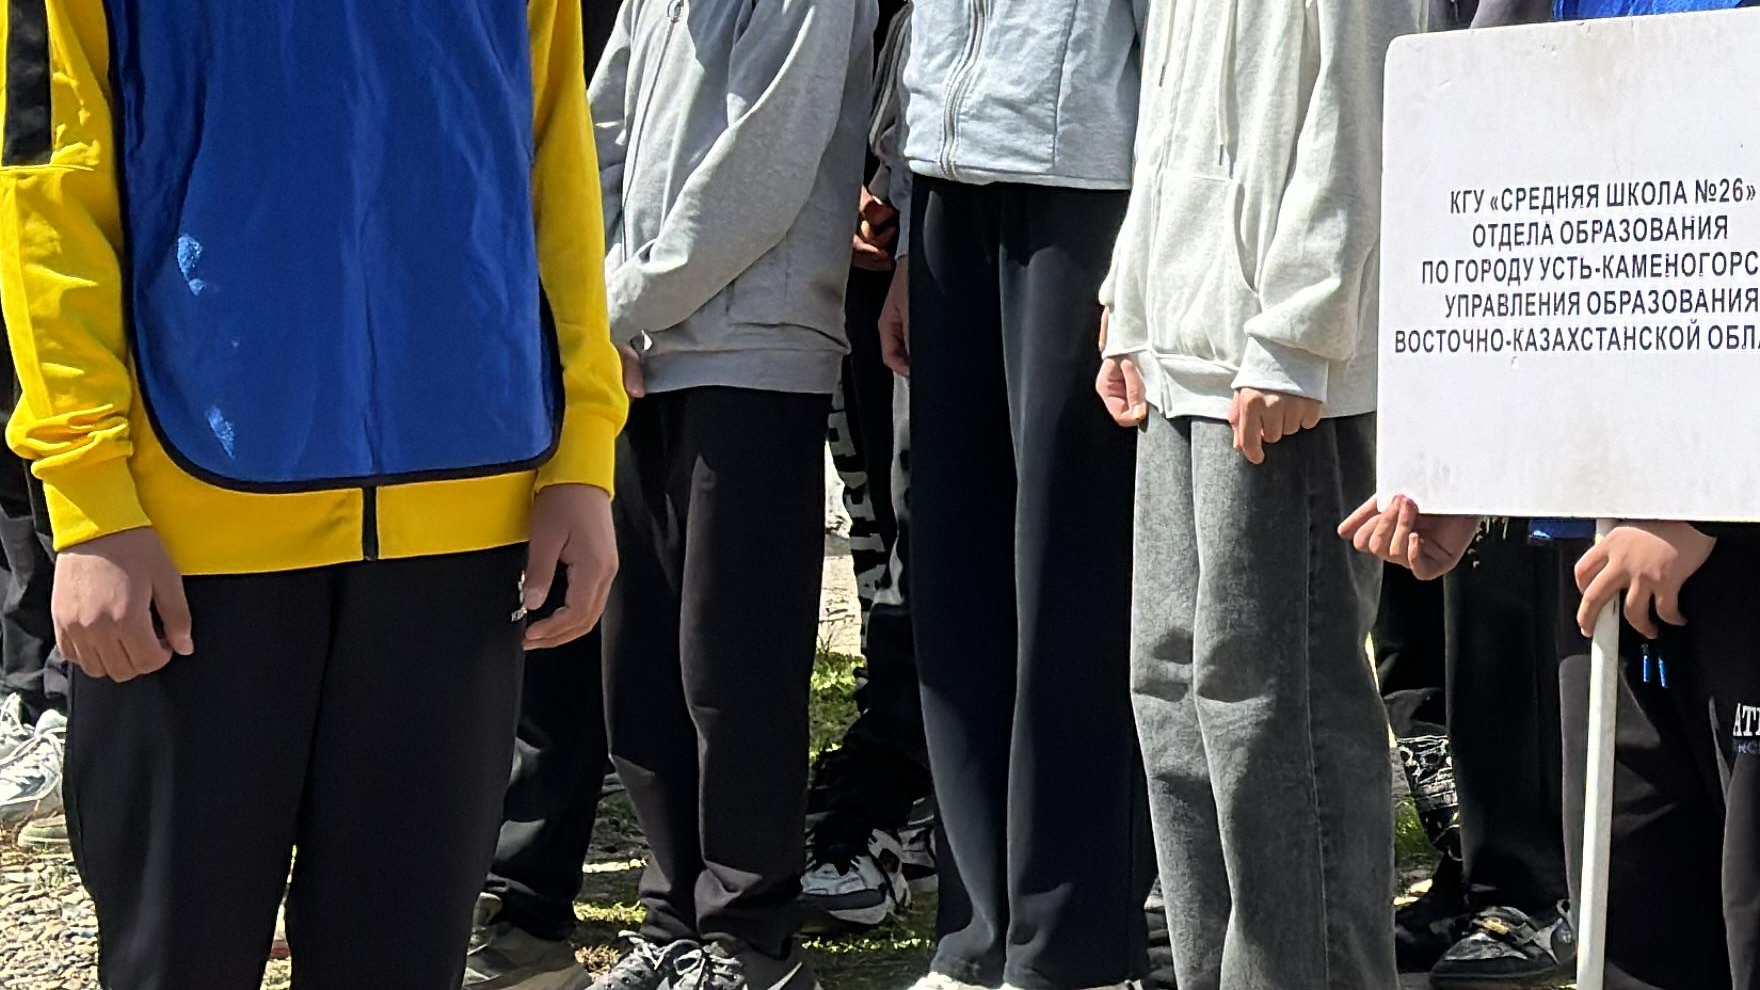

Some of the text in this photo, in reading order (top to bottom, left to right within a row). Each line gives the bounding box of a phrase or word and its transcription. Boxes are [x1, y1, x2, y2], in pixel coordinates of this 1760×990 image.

[1451, 178, 1756, 214] КГУ «СРЕДНЯЯ ШКОЛА №26»
[1472, 216, 1728, 250] ОТДЕЛА ОБРАЗОВАНИЯ
[1422, 259, 1449, 284] ПО
[1454, 257, 1534, 286] ГОРОДУ
[1445, 288, 1759, 318] УПРАВЛЕНИЯ ОБРАЗОВАНИЯ
[1395, 320, 1700, 353] ВОСТОЧНО-КАЗАХСТАНСКОЙ
